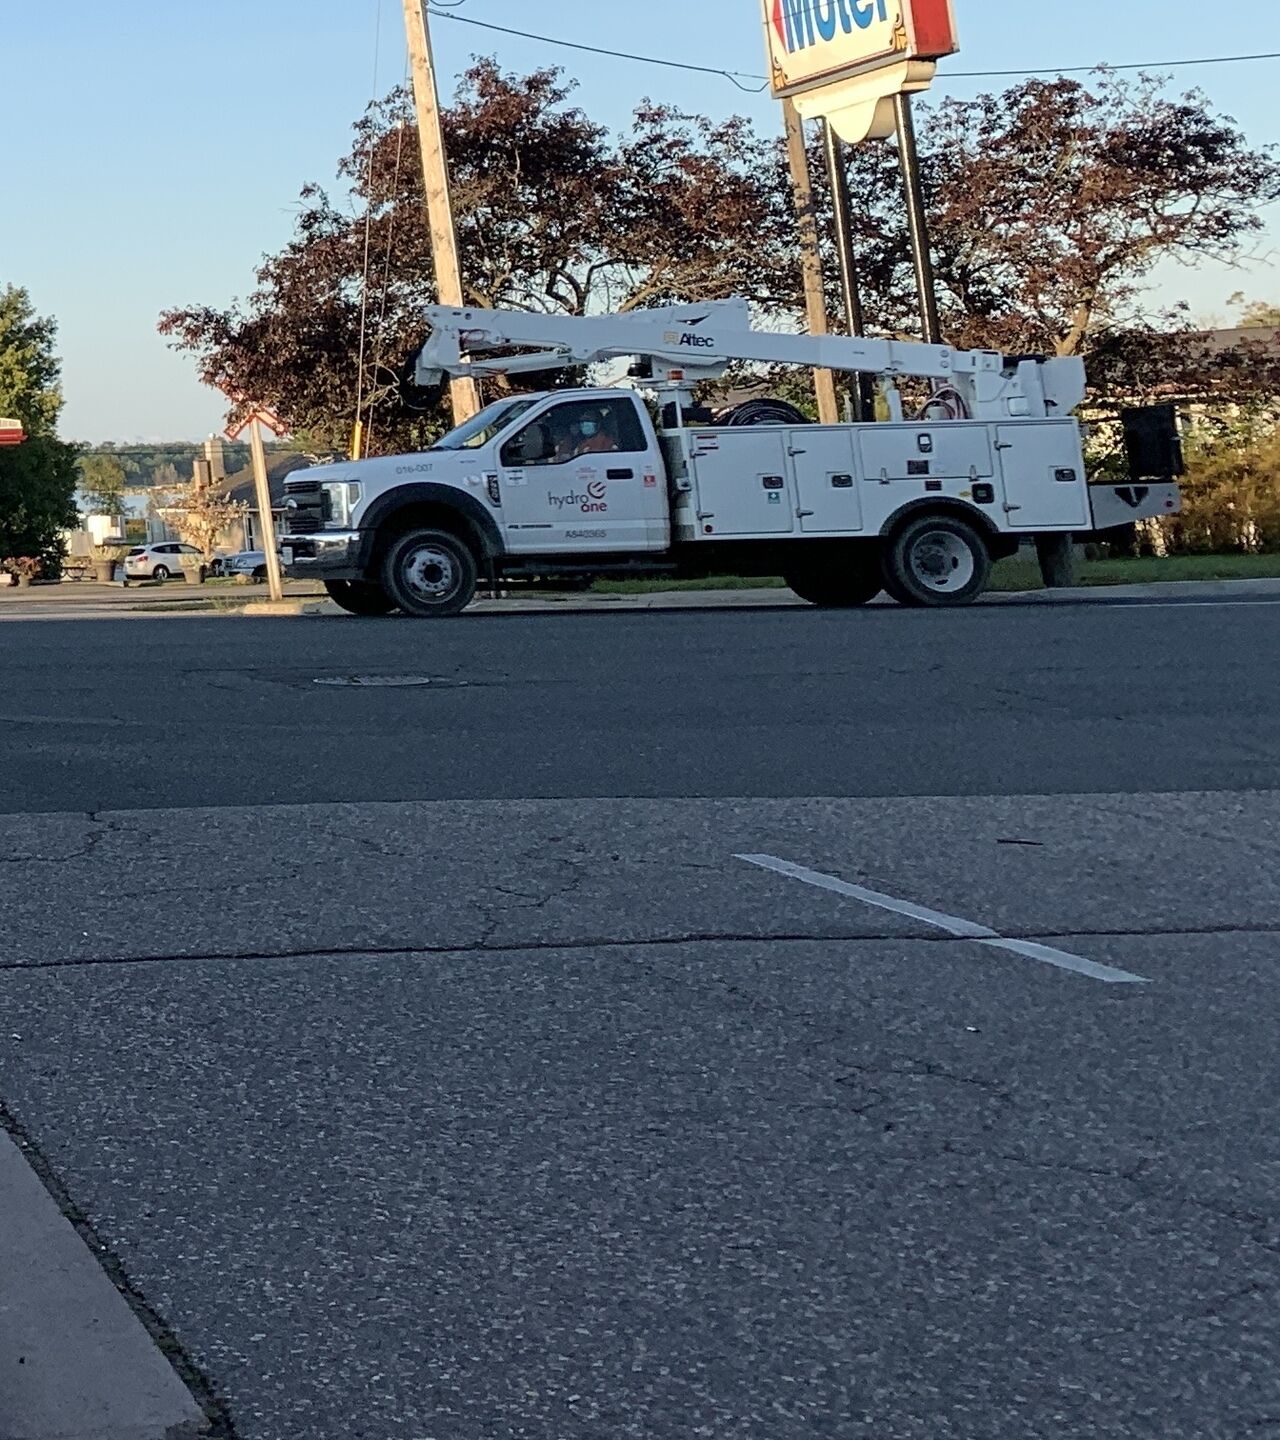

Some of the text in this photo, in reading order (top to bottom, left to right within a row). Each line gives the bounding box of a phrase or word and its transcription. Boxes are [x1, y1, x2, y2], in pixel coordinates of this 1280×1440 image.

[680, 332, 715, 348] Altec
[547, 489, 589, 510] hydro
[580, 502, 608, 513] one
